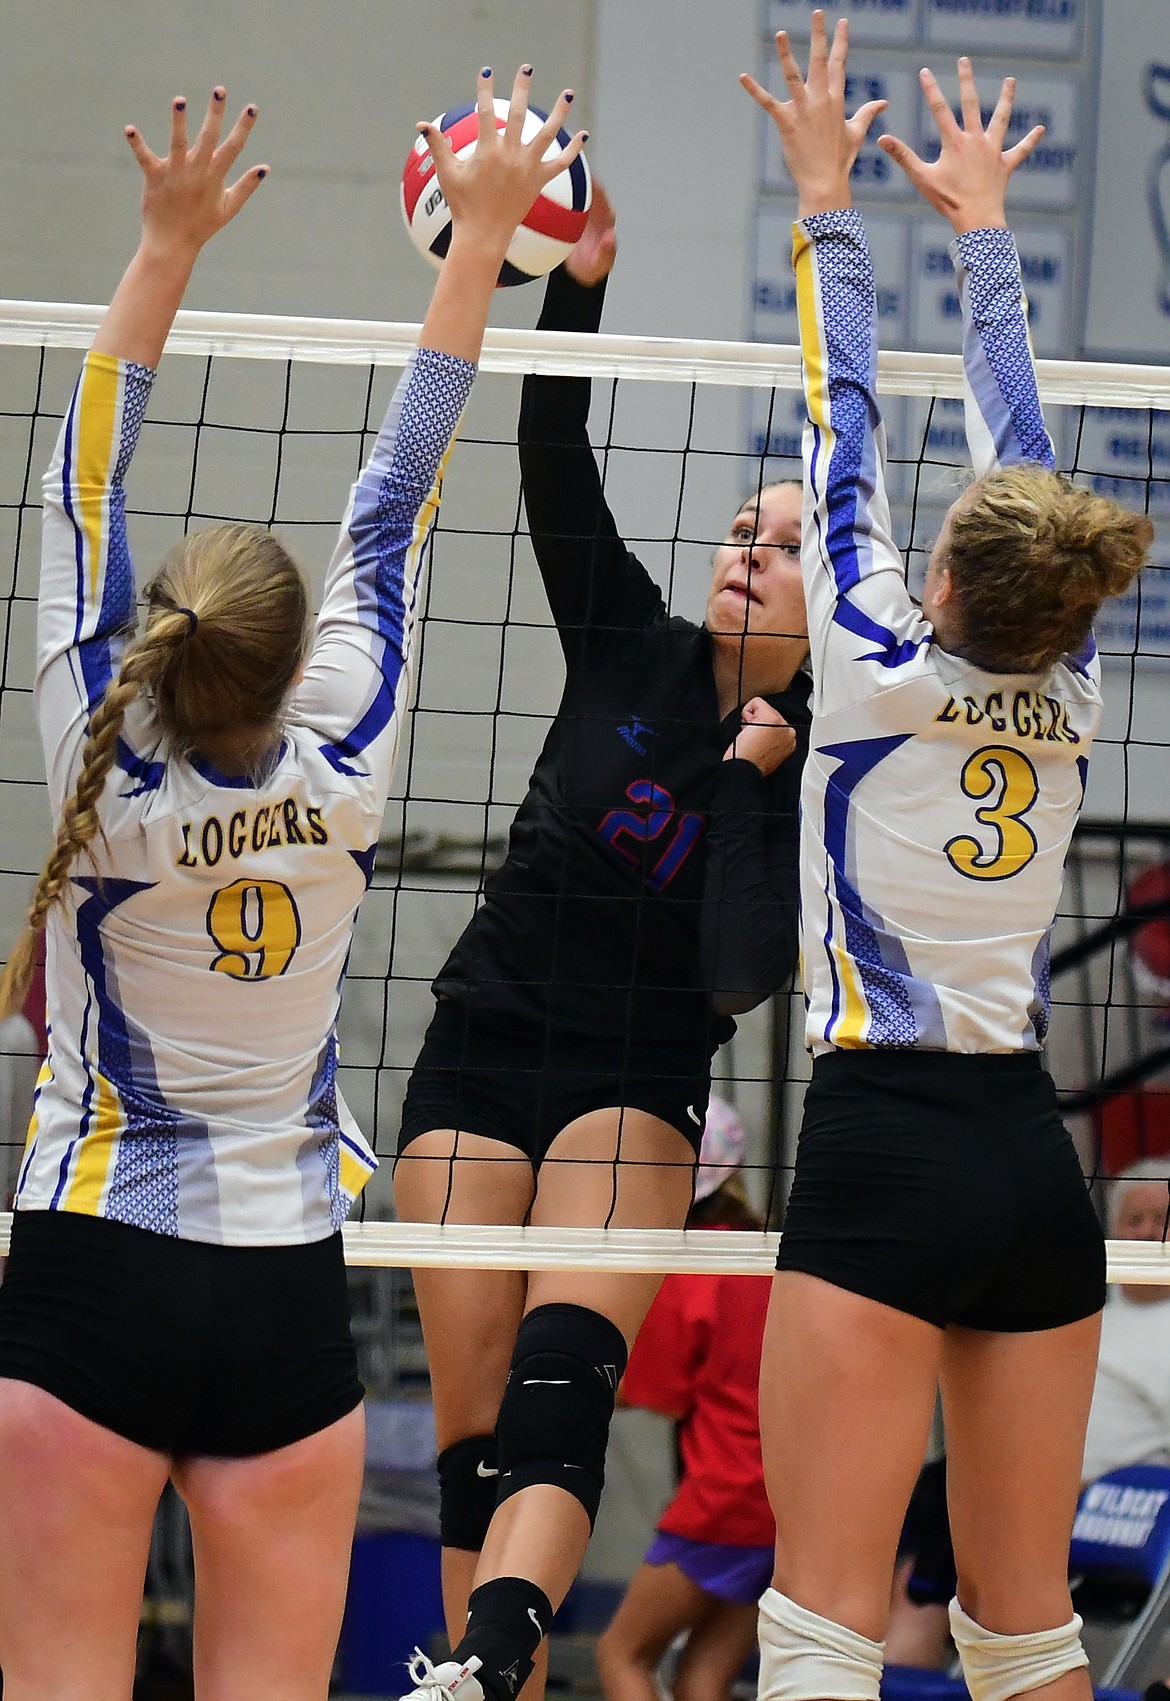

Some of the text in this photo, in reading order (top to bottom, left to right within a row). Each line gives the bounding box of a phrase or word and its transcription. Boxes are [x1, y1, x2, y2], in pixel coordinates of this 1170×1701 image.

[177, 797, 330, 867] LOGGERS
[598, 779, 707, 891] 21
[943, 745, 1040, 882] 3
[206, 877, 301, 982] 9
